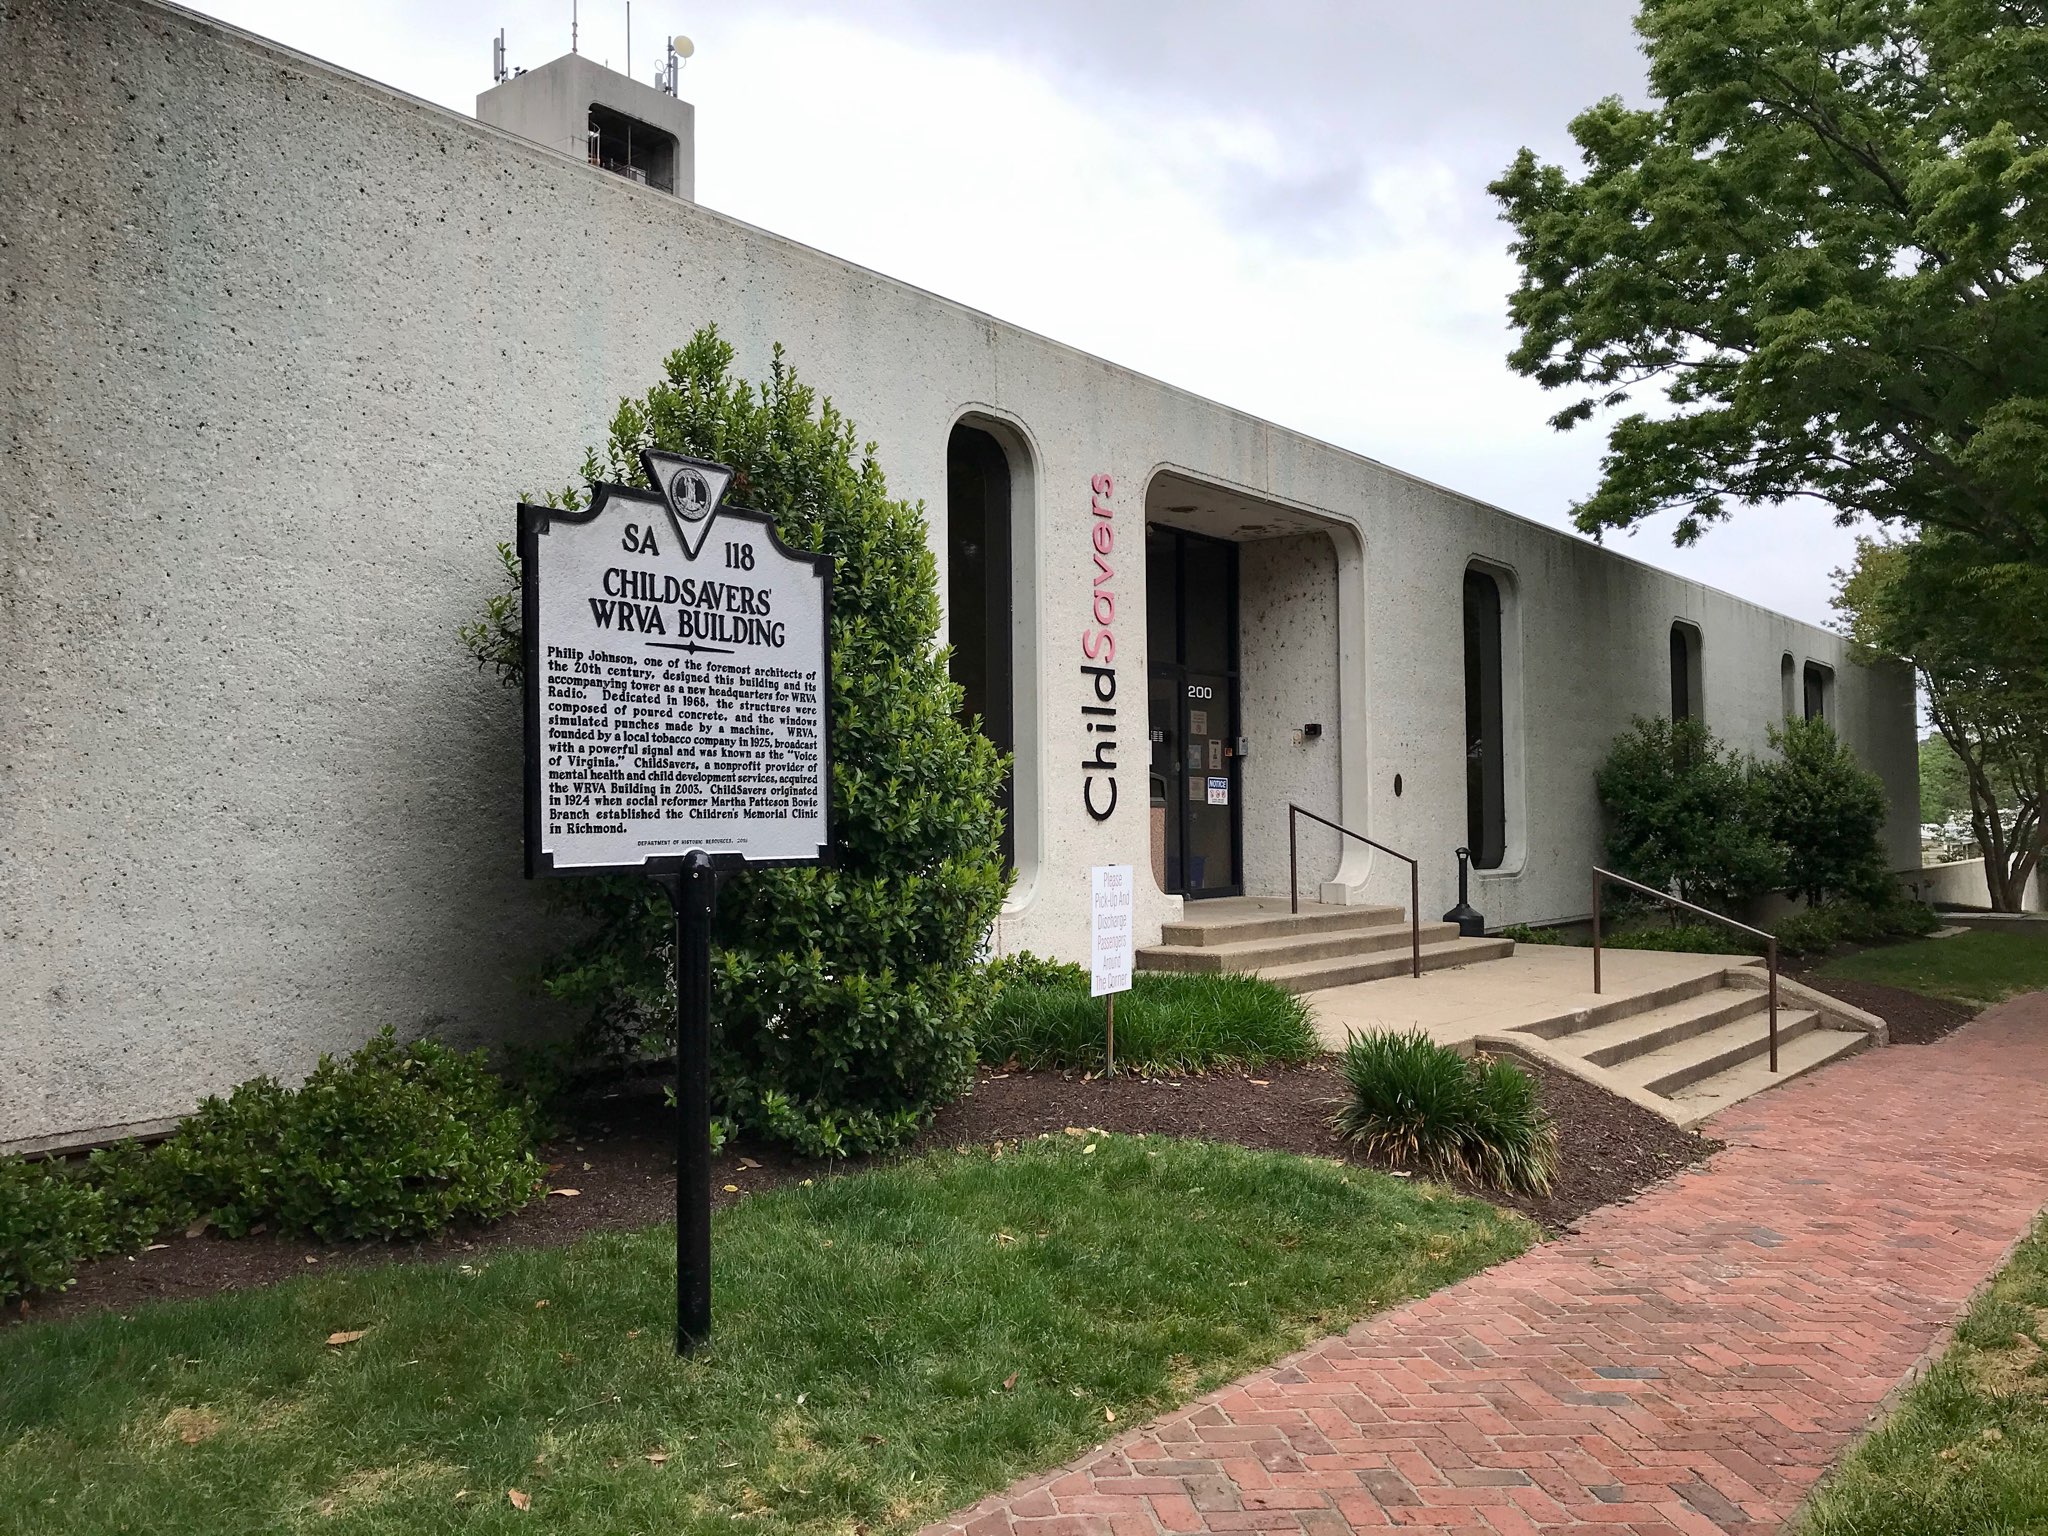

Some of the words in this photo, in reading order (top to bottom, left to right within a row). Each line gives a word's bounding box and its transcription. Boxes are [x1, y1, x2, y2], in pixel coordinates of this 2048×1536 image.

[622, 523, 660, 556] SA
[725, 542, 755, 571] 118
[603, 568, 772, 616] CHILDSAVERS'
[588, 598, 666, 635] WRVA
[678, 609, 785, 648] BUILDING
[1081, 473, 1118, 822] ChildSavers
[547, 646, 583, 662] Philip
[643, 658, 663, 667] one
[667, 657, 679, 668] of
[684, 659, 702, 670] the
[706, 660, 750, 674] foremost
[754, 666, 802, 679] architects
[805, 669, 816, 680] of
[547, 660, 568, 671] the
[574, 662, 601, 674] 20th
[662, 669, 710, 683] designed
[714, 673, 734, 685] this
[739, 675, 779, 690] building
[783, 679, 800, 690] and
[804, 680, 816, 691] its
[547, 676, 627, 691] accompanying
[630, 680, 660, 692] tower
[663, 684, 675, 693] as
[678, 685, 684, 693] a
[686, 686, 706, 695] new
[708, 685, 772, 700] headquarters
[775, 690, 789, 701] for
[791, 691, 816, 703] WRVA
[1188, 685, 1212, 699] 200
[547, 686, 586, 699] Radio.
[602, 690, 660, 704] Dedicated
[666, 695, 677, 705] in
[716, 698, 734, 709] the
[739, 700, 790, 713] structures
[795, 706, 817, 715] were
[548, 703, 607, 714] composed
[613, 704, 627, 715] of
[632, 707, 673, 718] poured
[734, 712, 753, 722] and
[757, 713, 774, 724] the
[779, 714, 817, 726] windows
[548, 715, 608, 727] simulated
[614, 719, 659, 730] punches
[665, 721, 693, 732] made
[698, 721, 712, 735] by
[718, 725, 724, 733] a
[729, 724, 773, 735] machine.
[548, 728, 595, 740] founded
[596, 730, 612, 743] by
[614, 734, 621, 742] a
[623, 731, 649, 743] local
[651, 733, 691, 744] tobacco
[693, 737, 736, 748] company
[738, 736, 748, 747] in
[774, 737, 817, 750] broadcast
[548, 743, 574, 753] with
[578, 746, 585, 754] a
[588, 744, 638, 756] powerful
[641, 745, 673, 758] signal
[676, 746, 695, 757] and
[699, 749, 717, 758] was
[720, 747, 751, 759] known
[754, 751, 765, 759] as
[768, 749, 784, 760] the
[548, 755, 561, 766] of
[704, 761, 710, 769] a
[713, 759, 761, 772] nonprofit
[765, 760, 804, 772] provider
[807, 760, 818, 771] of
[548, 770, 587, 780] mental
[589, 770, 625, 781] health
[626, 770, 646, 781] and
[647, 771, 674, 782] child
[675, 771, 736, 784] development
[779, 773, 817, 785] acquired
[548, 783, 569, 793] the
[573, 782, 606, 794] WRVA
[610, 783, 656, 796] Building
[659, 784, 671, 794] in
[675, 783, 702, 794] 2003.
[709, 783, 766, 794] ChildSavers
[770, 784, 817, 797] originated
[549, 795, 561, 806] in
[565, 795, 590, 806] 1924
[594, 795, 622, 806] when
[626, 795, 658, 806] social
[661, 795, 708, 806] reformer
[711, 795, 746, 806] Martha
[748, 795, 789, 807] Patteson
[792, 796, 818, 807] Bowie
[549, 809, 589, 820] Branch
[595, 809, 660, 820] established
[665, 809, 683, 819] the
[689, 808, 738, 819] Children's
[743, 808, 787, 819] Memorial
[791, 808, 818, 819] Clinic
[549, 823, 561, 834] in
[566, 823, 627, 834] Richmond.
[1103, 872, 1123, 888] Please
[1095, 892, 1119, 909] Pick-Up
[1119, 889, 1130, 906] And
[1097, 913, 1127, 931] Discharge
[1097, 934, 1127, 951] Passengers
[1103, 956, 1121, 971] Around
[1096, 974, 1107, 992] The
[1107, 972, 1127, 989] Corner
